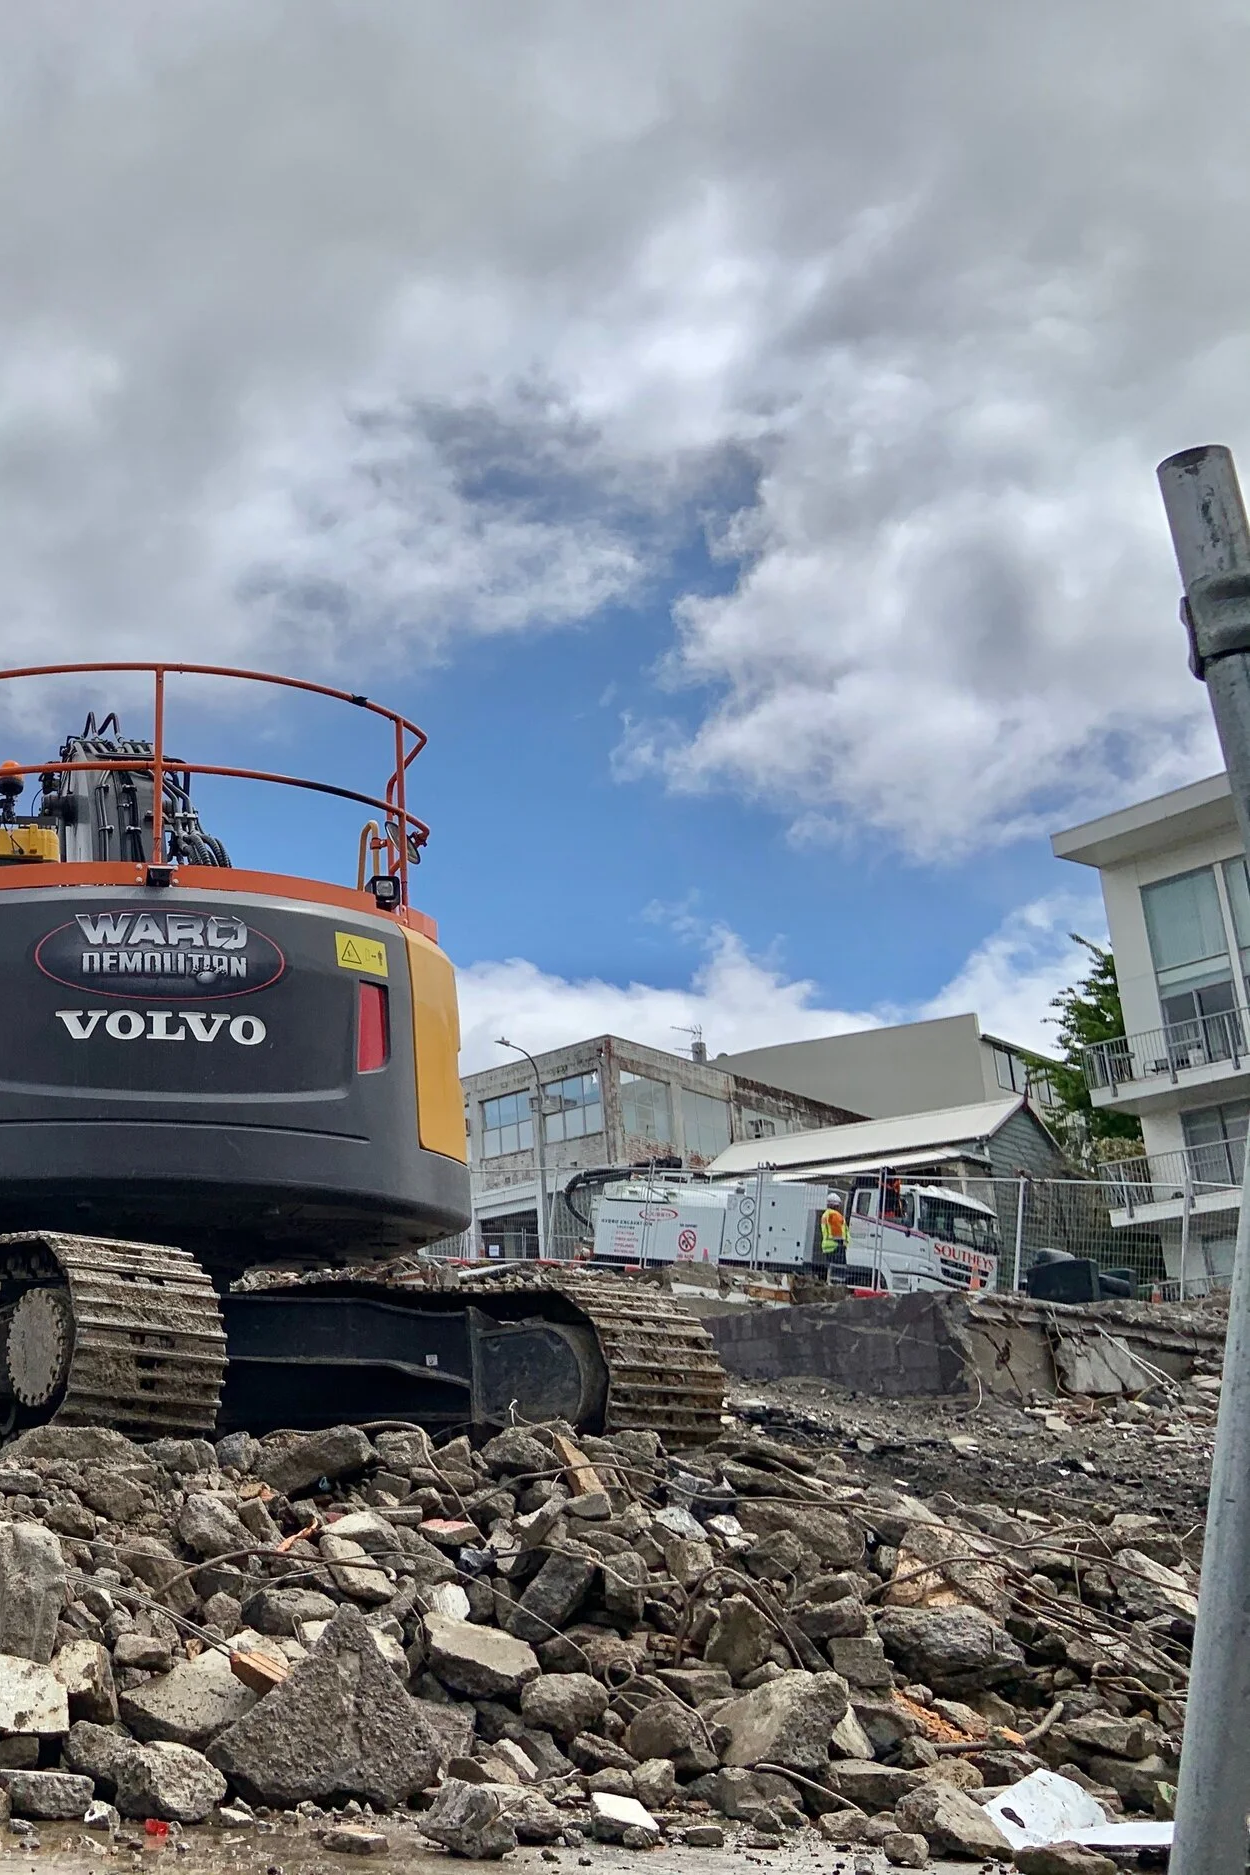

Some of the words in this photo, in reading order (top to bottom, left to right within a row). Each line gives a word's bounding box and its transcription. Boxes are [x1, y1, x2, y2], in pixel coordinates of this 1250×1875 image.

[75, 913, 248, 950] WARD
[82, 952, 248, 980] DEMOLITION
[55, 1009, 267, 1046] VOLVO
[934, 1242, 994, 1272] SOUTHEYS
